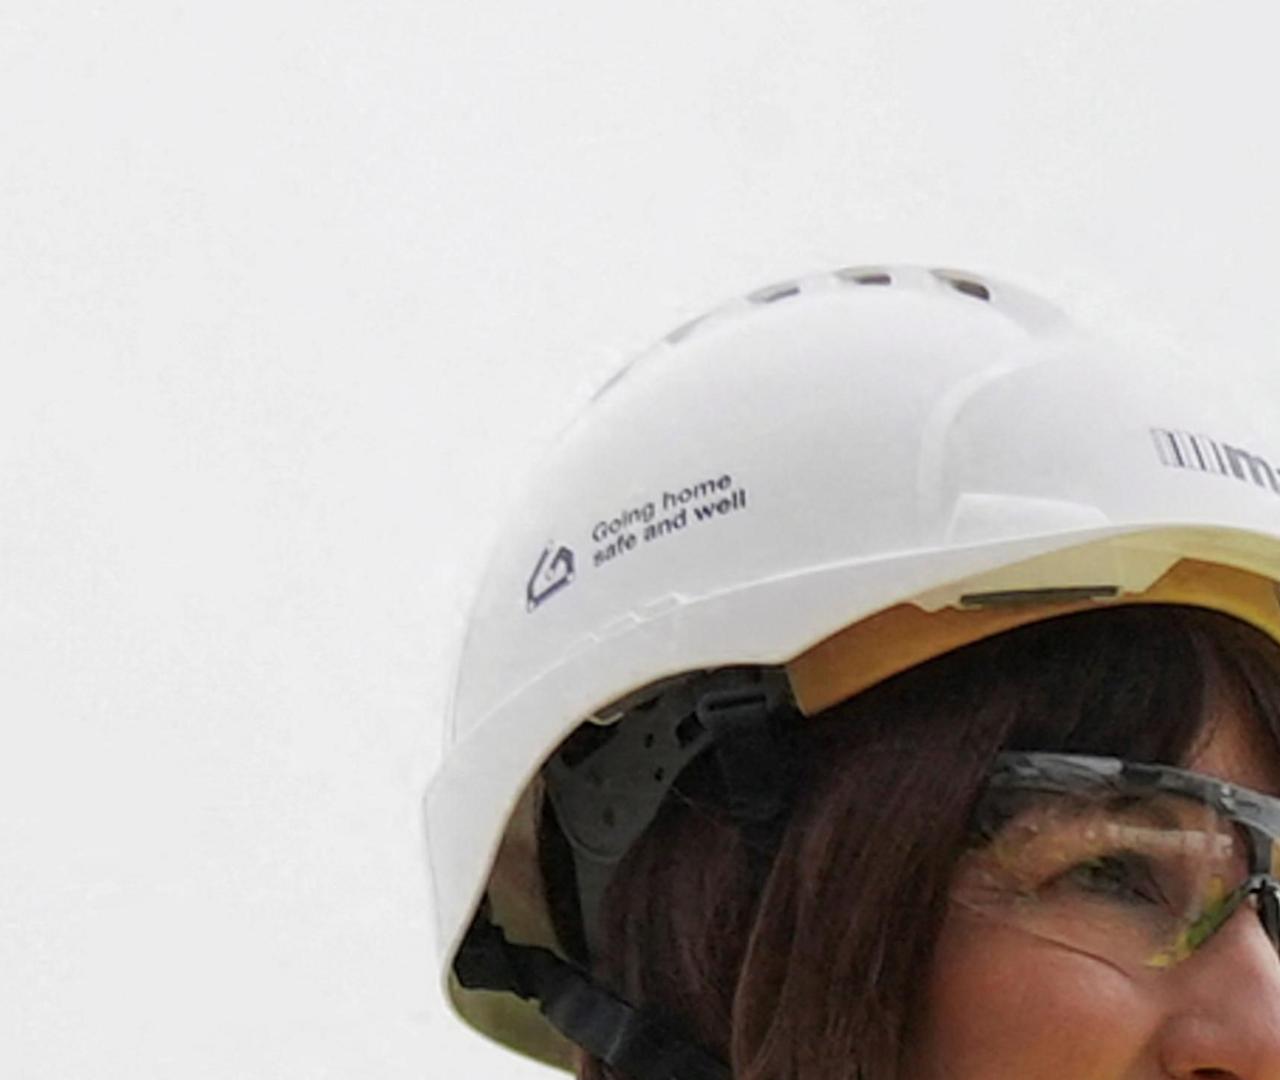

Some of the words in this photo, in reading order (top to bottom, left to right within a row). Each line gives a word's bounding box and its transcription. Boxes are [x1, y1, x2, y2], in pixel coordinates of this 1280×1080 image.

[592, 502, 655, 542] Going
[662, 474, 732, 510] home
[593, 534, 637, 567] safe
[644, 508, 687, 542] and
[694, 488, 746, 521] well
